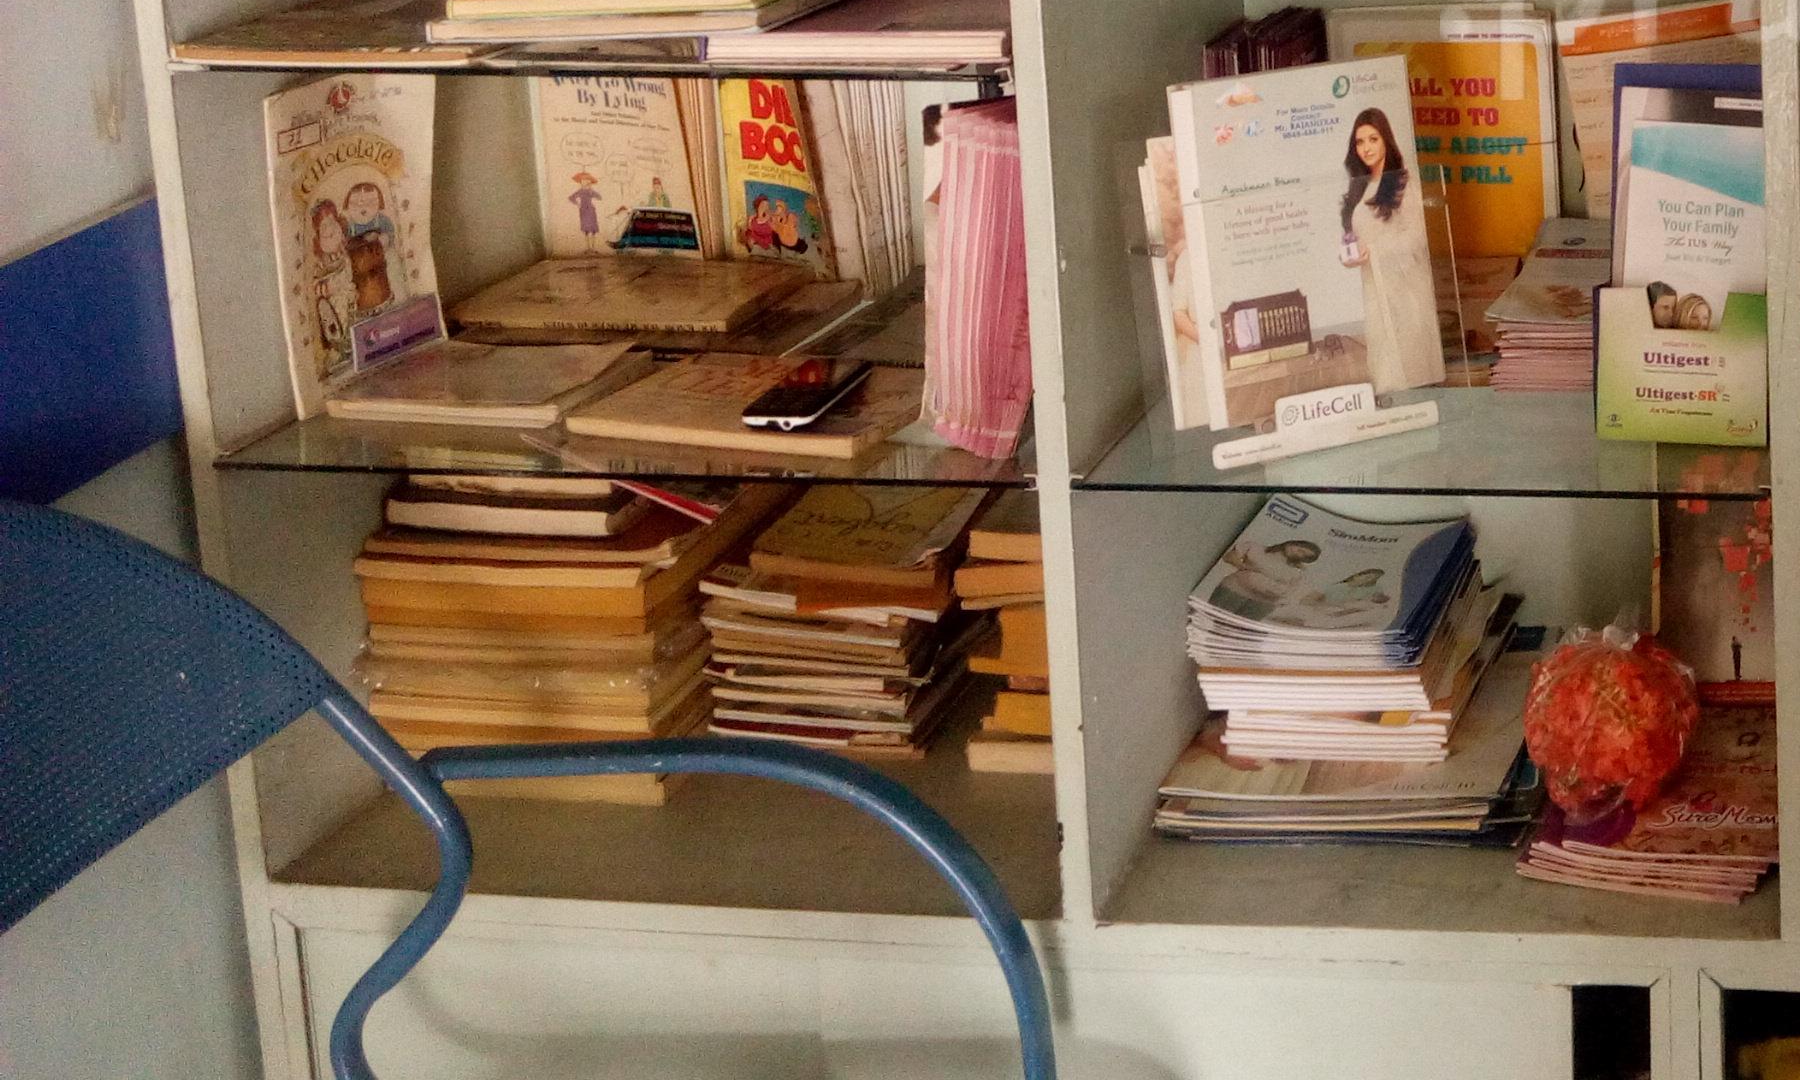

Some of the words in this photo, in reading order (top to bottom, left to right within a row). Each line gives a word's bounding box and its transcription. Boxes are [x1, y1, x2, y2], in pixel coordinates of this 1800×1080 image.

[1450, 77, 1496, 97] YOU
[577, 88, 596, 107] By
[603, 89, 648, 112] Lying
[1415, 107, 1461, 126] EED
[1468, 107, 1500, 126] TO
[1451, 135, 1529, 155] ABOUT
[1460, 166, 1514, 185] PILL
[1658, 200, 1682, 214] You
[1685, 200, 1711, 215] Can
[1715, 202, 1745, 218] Plan
[1663, 217, 1692, 233] Your
[1695, 219, 1739, 239] Family
[1688, 238, 1708, 248] IUS
[1643, 351, 1710, 368] Ultigest
[1302, 394, 1363, 421] LifeCell
